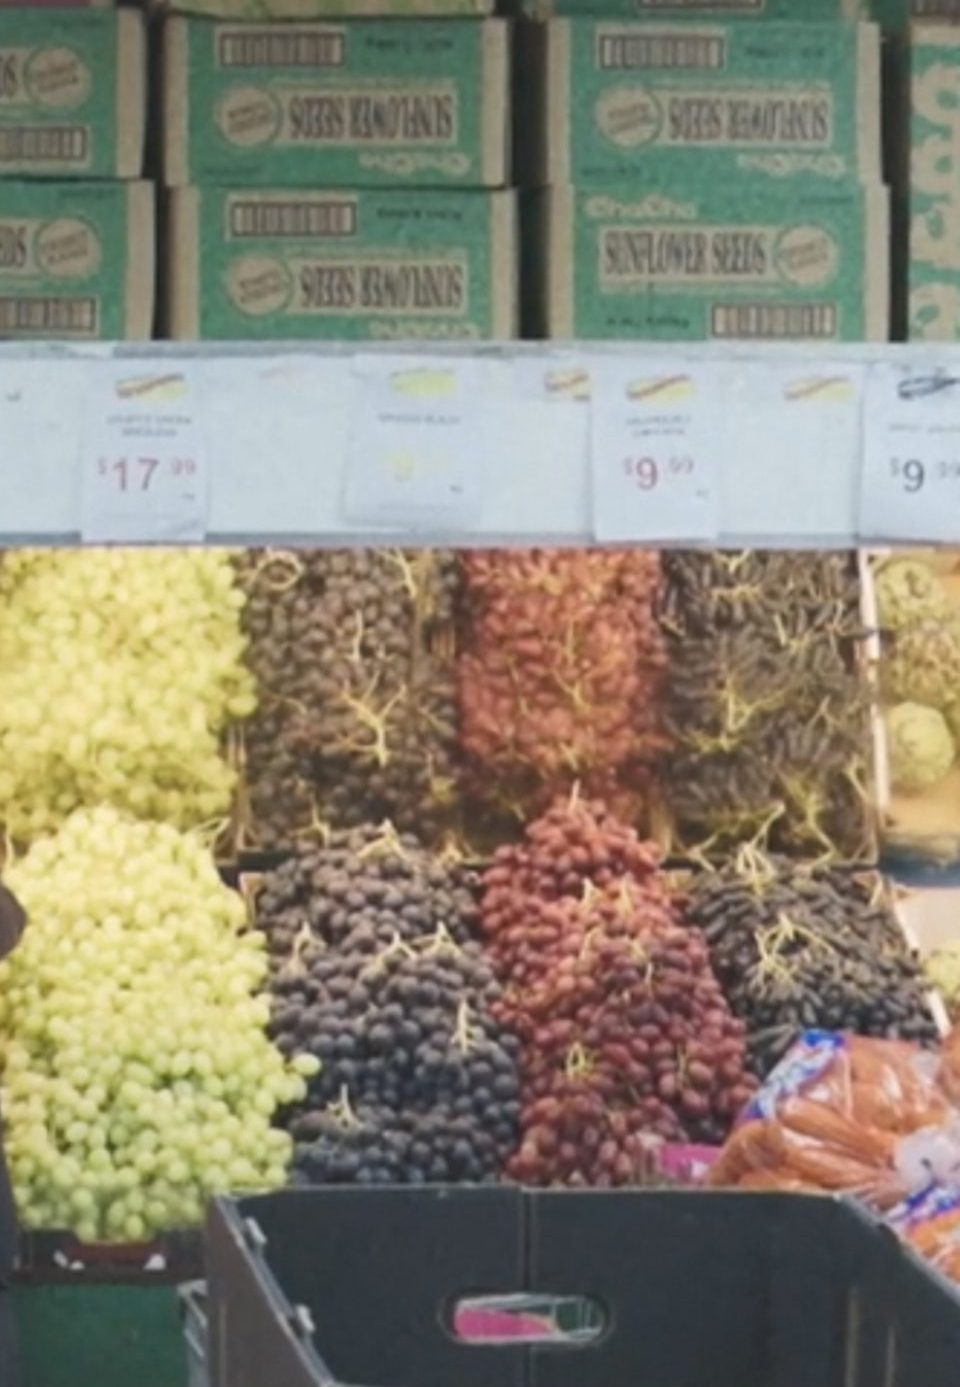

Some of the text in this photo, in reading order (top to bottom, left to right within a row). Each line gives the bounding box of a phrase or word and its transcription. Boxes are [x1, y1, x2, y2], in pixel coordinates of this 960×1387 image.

[290, 95, 345, 140] SEEDS
[348, 94, 454, 140] SUNFLOWER
[668, 97, 724, 141] SEEDS
[726, 97, 829, 141] SUNFLOWER
[603, 229, 708, 276] SUNFLOWER
[709, 229, 768, 276] SEEDS
[299, 265, 356, 309] SEEDS
[359, 264, 465, 309] SUNFLOWER
